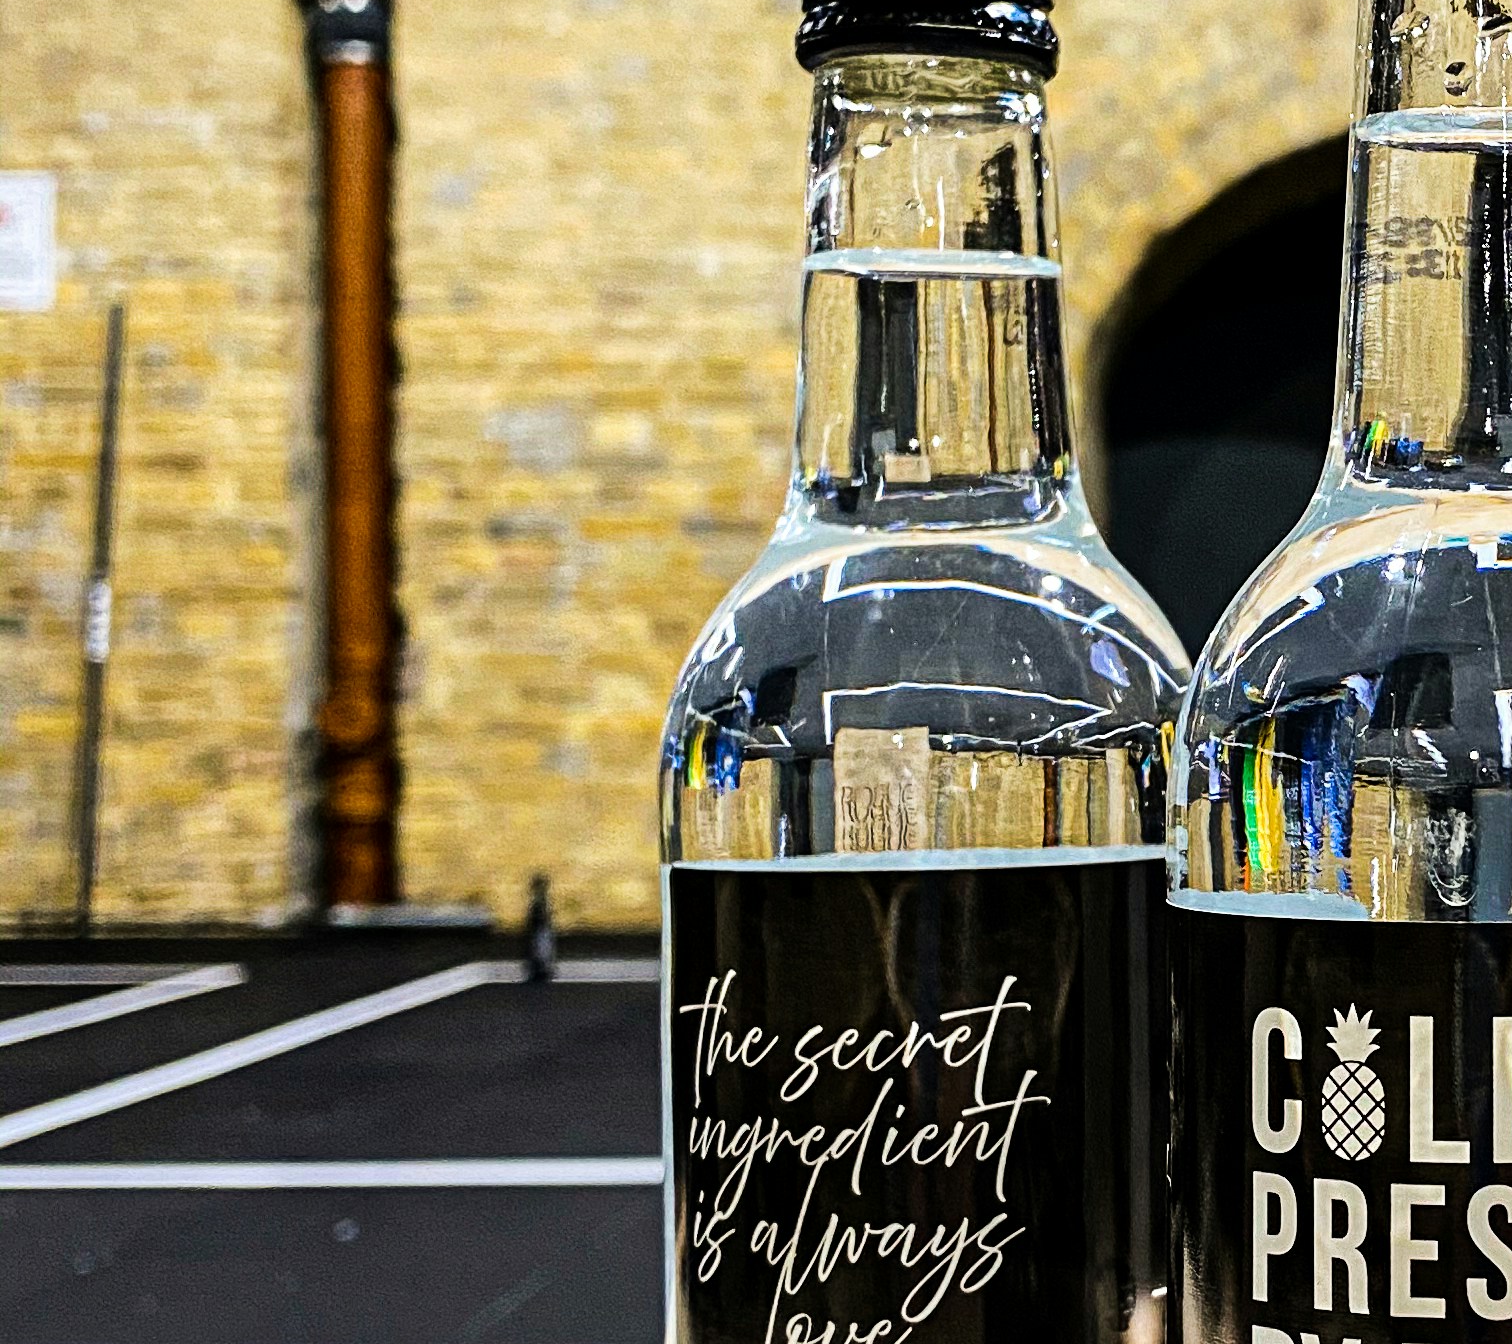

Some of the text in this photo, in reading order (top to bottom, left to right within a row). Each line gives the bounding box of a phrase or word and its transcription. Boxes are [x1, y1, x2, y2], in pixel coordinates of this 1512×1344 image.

[680, 969, 1032, 1108] the secret
[689, 1069, 1051, 1218] ingredient
[693, 1155, 1027, 1323] is always
